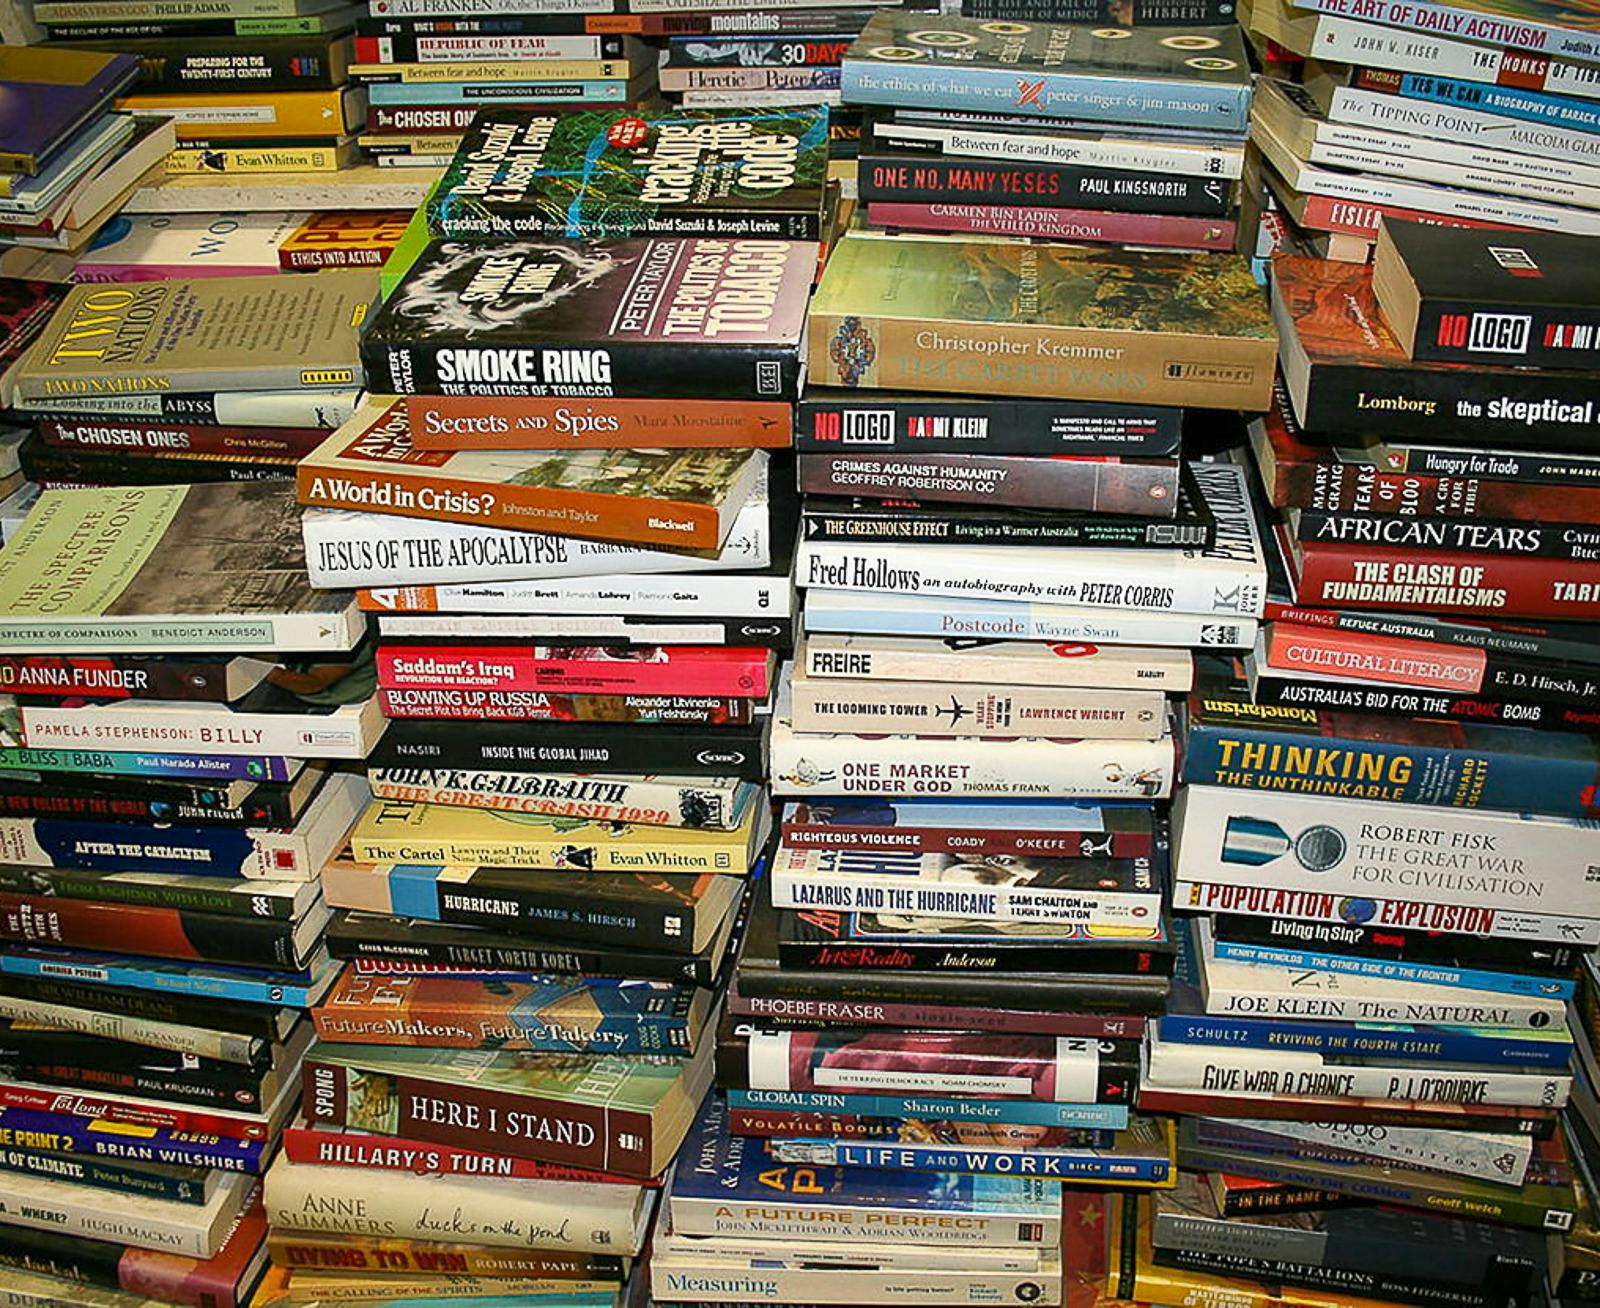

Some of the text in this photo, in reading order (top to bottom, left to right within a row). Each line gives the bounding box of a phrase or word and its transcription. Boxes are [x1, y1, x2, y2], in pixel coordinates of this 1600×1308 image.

[712, 13, 779, 30] mountains
[1350, 0, 1547, 47] ART OF DAILY ACTIVISM
[420, 39, 545, 49] REPUBLIC OF FEAR
[186, 56, 264, 68] PREPARING FOR THE
[181, 68, 272, 79] TWENTY-FIRST CENTURY
[859, 76, 879, 88] the
[883, 78, 920, 91] ethics
[941, 81, 968, 94] what
[975, 86, 991, 96] we
[995, 87, 1012, 97] eat
[1342, 100, 1481, 134] The TIPPING POINT
[1080, 179, 1187, 196] PAUL KINGSNORTH
[930, 204, 1058, 222] CARMEN BIN LADIN
[648, 219, 673, 230] David
[675, 219, 704, 231] Suzuki
[707, 220, 715, 231] &
[718, 220, 748, 233] Joseph
[751, 220, 780, 232] Levine
[971, 219, 1101, 237] THE VEILED KINGDOM
[291, 250, 382, 265] ETHICS INTO ACTION
[916, 332, 1123, 361] Christopher Kremmer
[436, 350, 612, 384] SMOKE RING
[1357, 393, 1591, 424] Lomborg the skeptical
[425, 408, 618, 433] Secrets AND Spies
[815, 412, 839, 440] NO
[846, 414, 890, 440] LOGO
[908, 417, 949, 438] NAOMI
[952, 418, 988, 439] KLEIN
[832, 461, 1007, 481] CRIMES AGAINST HUMANITY
[309, 478, 495, 515] A World in Crisis?
[502, 503, 599, 523] Johnston and Taylor
[648, 518, 694, 532] Blackwell
[1317, 517, 1540, 551] AFRICAN TEARS
[319, 535, 568, 571] JESUS OF THE APOCALYPSE
[809, 555, 1173, 607] Fred Hollows an autobiography with PETER CORRIS
[1354, 562, 1483, 586] THE CLASH OF
[1322, 583, 1506, 607] FUNDAMENTALISMS
[152, 628, 266, 637] BENEDICT ANDERSON
[942, 617, 1119, 638] Postcode Wayne Swan
[1339, 618, 1435, 638] REFUGE AUSTRALIA
[813, 653, 870, 673] FREIRE
[1287, 646, 1479, 683] CULTURAL LITERACY
[19, 671, 148, 688] ANNA FUNDER
[388, 692, 549, 706] BLOWING UP RUSSIA
[1019, 707, 1125, 721] LAWRENCE WRIGHT
[36, 725, 263, 743] PAMELA STEPHENSON: BILLY
[842, 763, 969, 779] ONE MARKET
[1218, 739, 1413, 784] THINKING
[842, 779, 951, 792] UNDER GOD
[963, 783, 1050, 793] THOMAS FRANK
[1216, 770, 1253, 786] THE
[1258, 775, 1404, 801] UNTHINKABLE
[790, 832, 1065, 849] RIGHTEOUS VIOLENCE COADY O'KEEFE
[1360, 824, 1498, 850] ROBERT FISK
[610, 851, 707, 867] Evan Whitton
[444, 895, 519, 916] HURRICANE
[1206, 884, 1332, 918] POPULATION
[1380, 900, 1494, 933] EXPLOSION
[1224, 996, 1513, 1023] JOE KLEIN The NATURAL
[138, 1078, 214, 1096] PAUL KRUGMAN
[315, 1069, 334, 1116] SPONG
[747, 1091, 845, 1107] GLOBAL SPIN
[903, 1101, 1000, 1117] Sharon Beder
[410, 1098, 596, 1148] HERE I STAND
[96, 1142, 244, 1171] BRIAN WILSHIRE
[319, 1144, 512, 1176] HILLARY'S TURN
[846, 1149, 1061, 1174] LIFE AND WORK
[303, 1194, 366, 1218] ANNE
[279, 1211, 395, 1234] SUMMERS
[715, 1207, 990, 1230] A FUTURE PERFECT
[667, 1274, 777, 1296] Measuring
